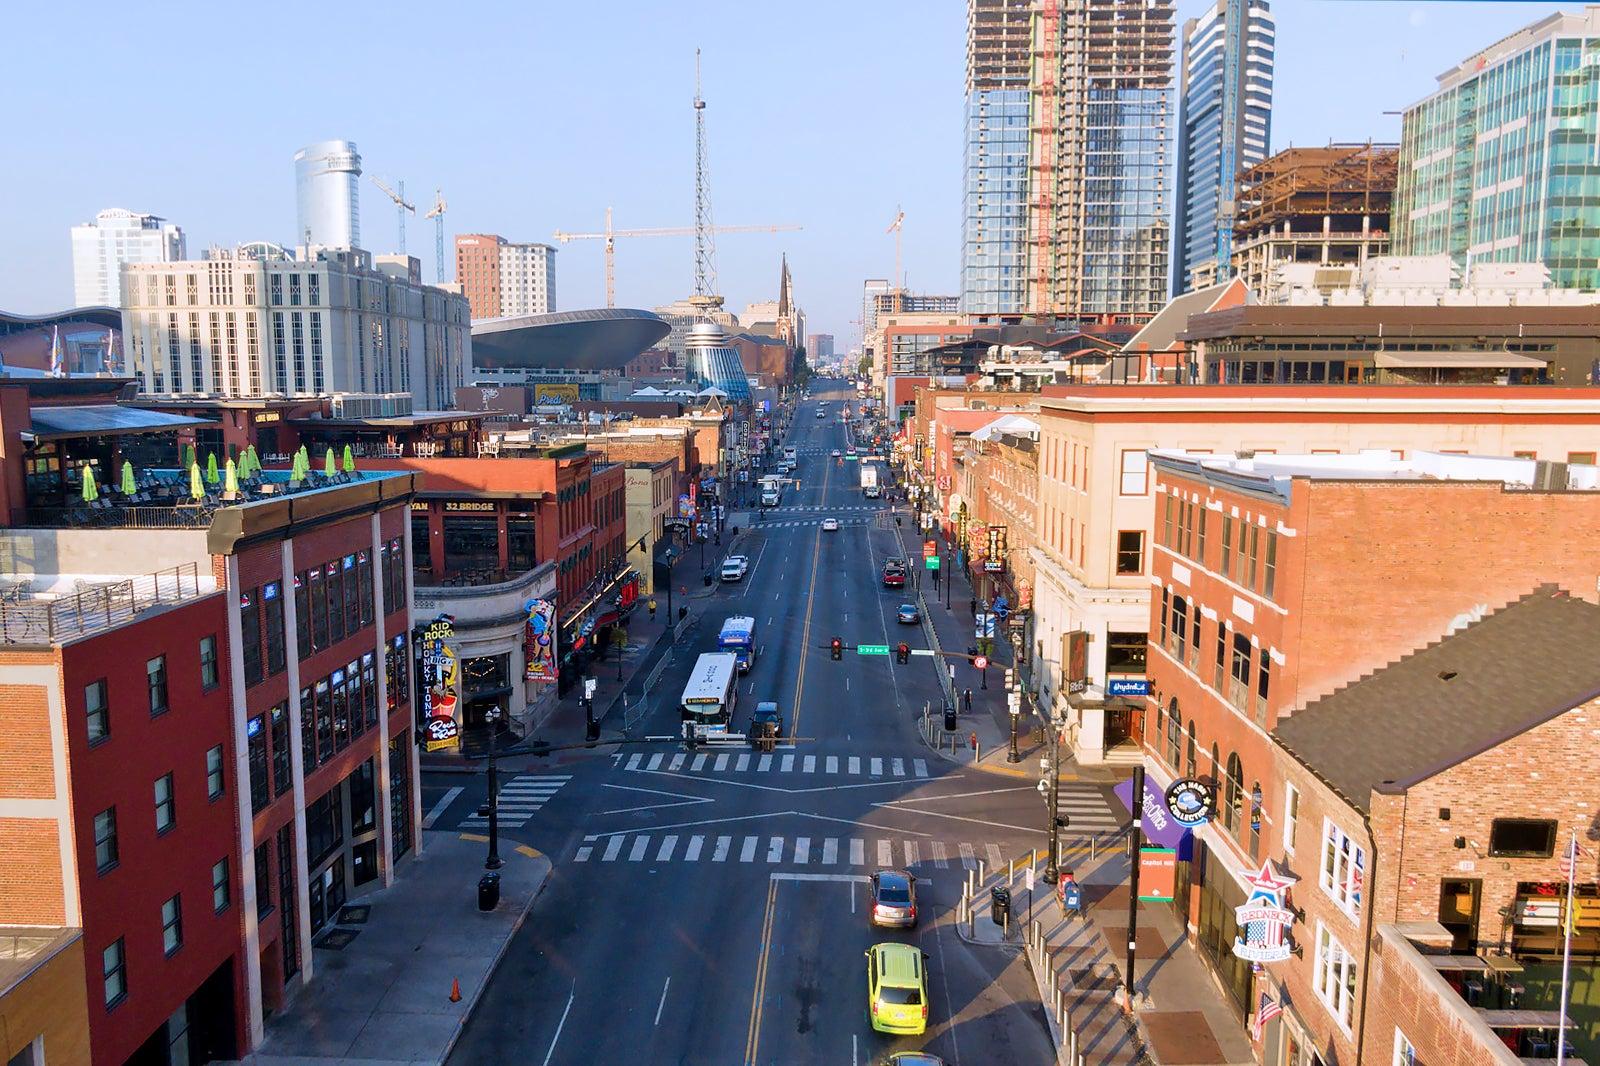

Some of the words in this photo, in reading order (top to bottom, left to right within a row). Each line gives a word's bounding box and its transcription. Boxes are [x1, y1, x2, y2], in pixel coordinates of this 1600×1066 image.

[446, 502, 458, 511] 32
[459, 502, 494, 511] BRIDGE
[431, 622, 450, 631] KID
[423, 642, 431, 682] HONKY
[424, 686, 432, 718] TONK
[1173, 783, 1188, 795] THE
[1169, 804, 1210, 822] COLLECTION
[1240, 908, 1291, 922] REDNECK
[1240, 947, 1288, 960] RIVIERA
